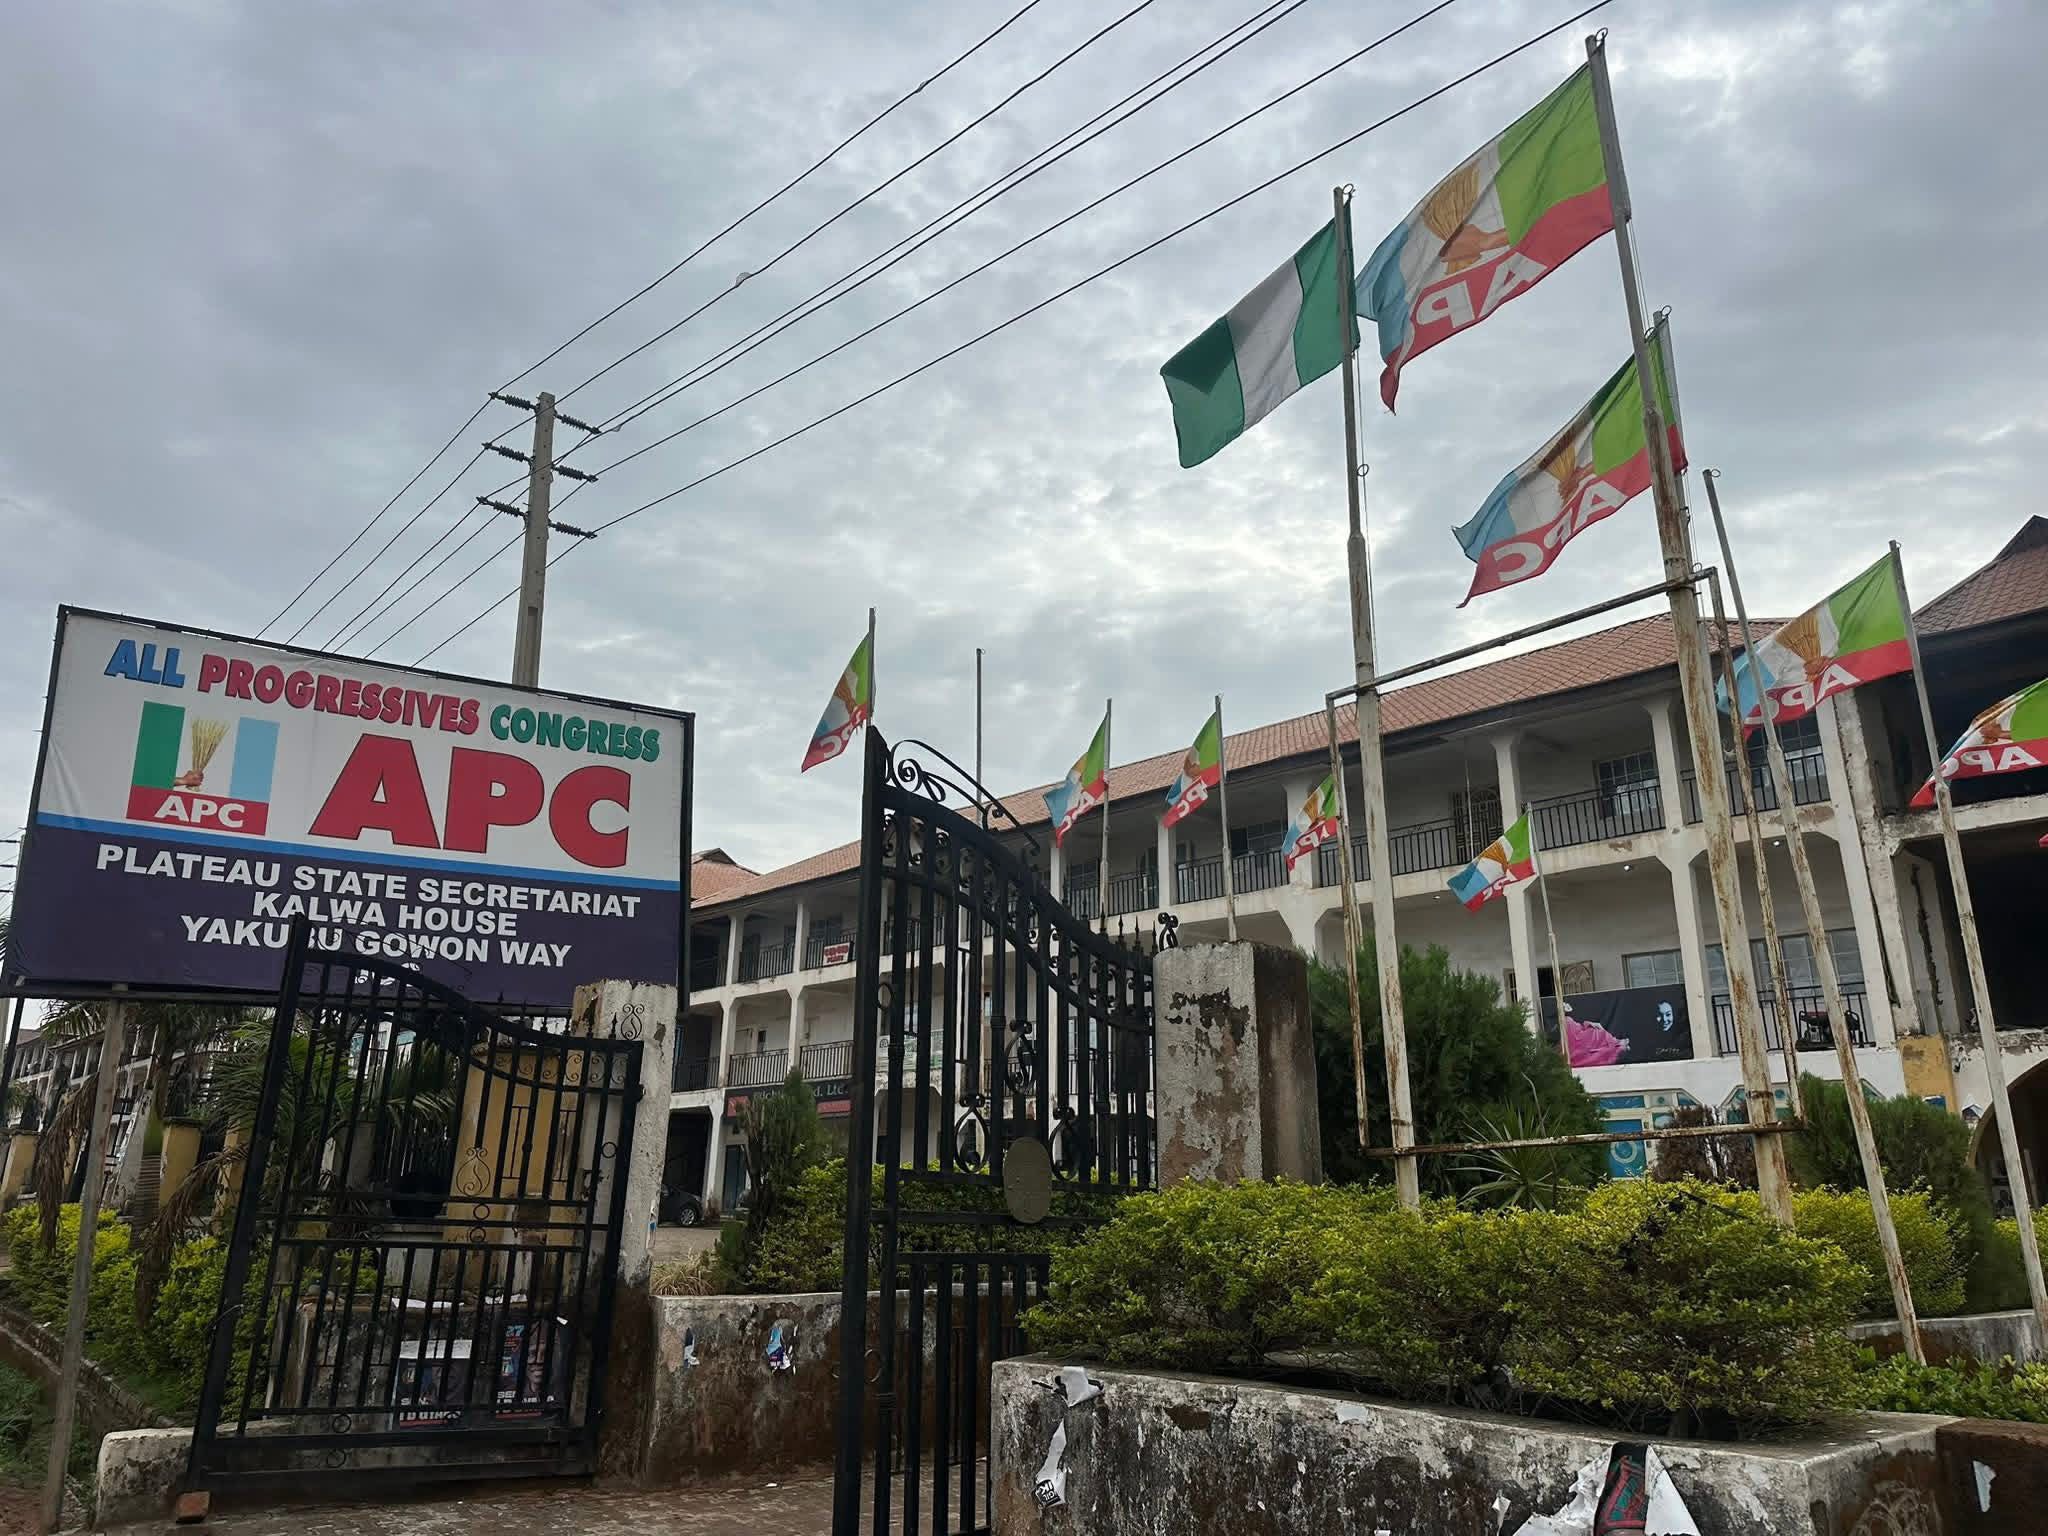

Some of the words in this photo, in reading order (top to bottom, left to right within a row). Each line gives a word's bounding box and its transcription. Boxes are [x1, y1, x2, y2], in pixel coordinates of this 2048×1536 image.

[104, 639, 185, 688] ALL
[198, 654, 480, 735] PROGRESSIVES
[490, 704, 660, 762] CONGRESS
[154, 795, 245, 828] APC
[308, 733, 631, 868] APC
[96, 843, 281, 887] PLATEAU
[293, 866, 407, 900] STATE
[418, 878, 641, 918] SECRETARIAT
[253, 891, 386, 927] KALWA
[398, 905, 517, 936] HOUSE
[355, 930, 488, 963] GOWON
[500, 940, 572, 968] WAY
